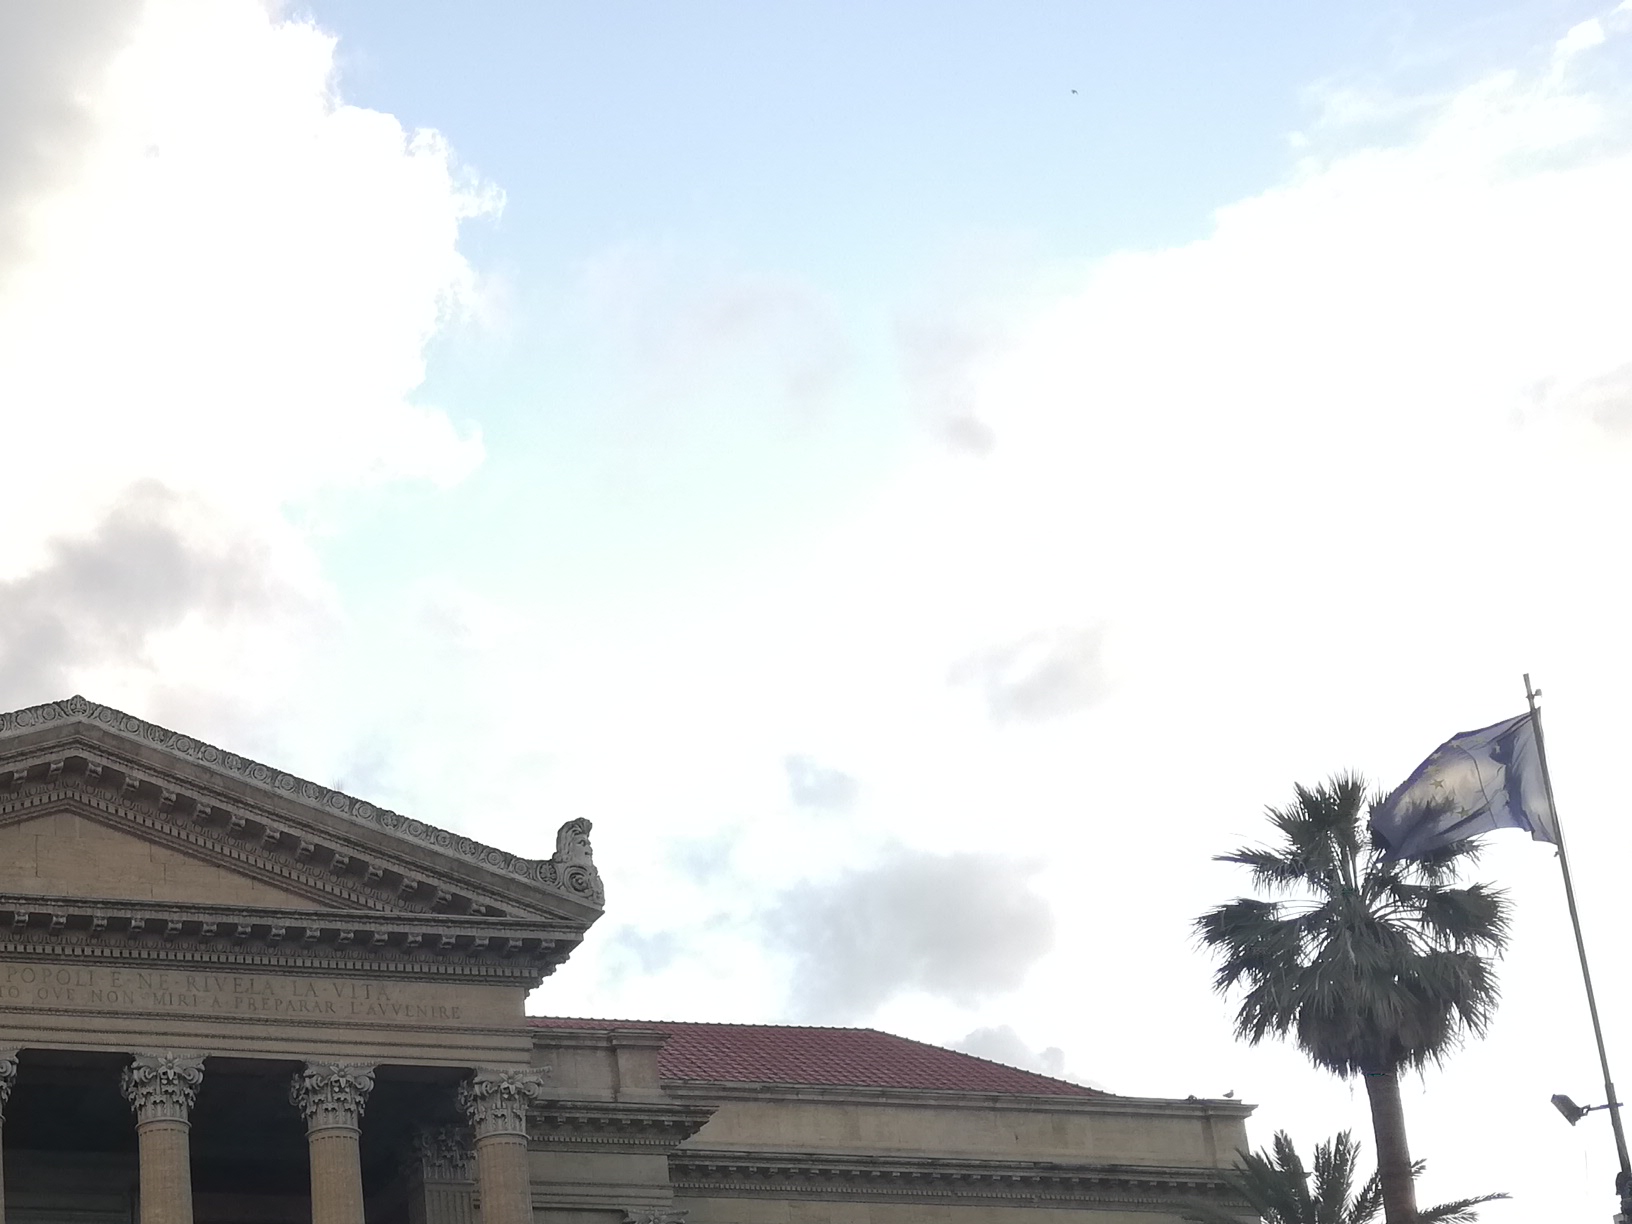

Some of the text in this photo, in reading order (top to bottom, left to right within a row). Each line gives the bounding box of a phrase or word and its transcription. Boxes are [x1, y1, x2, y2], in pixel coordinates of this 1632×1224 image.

[6, 966, 94, 987] POPOLI
[110, 971, 123, 989] E
[137, 971, 170, 991] NE
[186, 976, 276, 996] RIVELA
[293, 980, 319, 998] LA
[332, 982, 392, 1001] VITA
[37, 985, 75, 1001] OVE
[90, 987, 135, 1005] NON
[151, 991, 199, 1008] MIRI
[209, 995, 223, 1009] A
[233, 996, 337, 1014] PREPARAR
